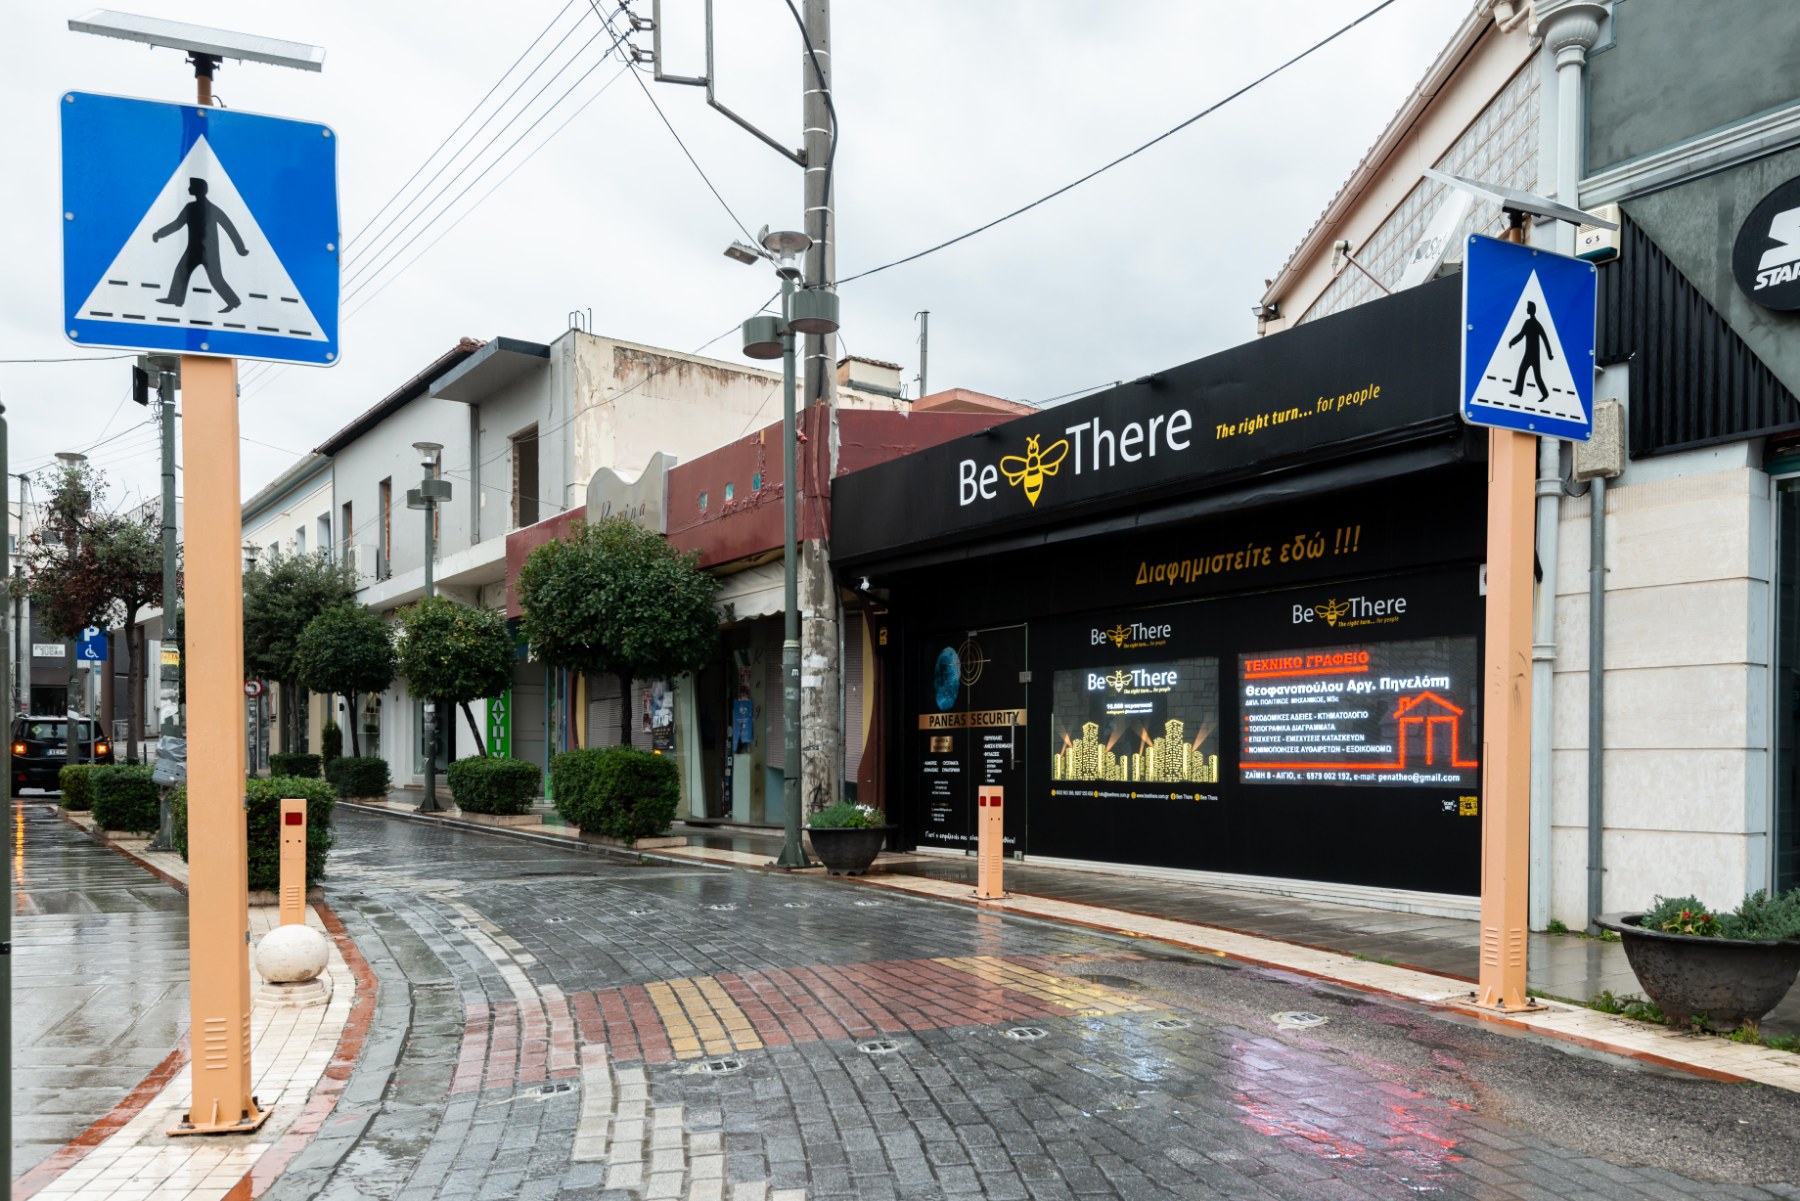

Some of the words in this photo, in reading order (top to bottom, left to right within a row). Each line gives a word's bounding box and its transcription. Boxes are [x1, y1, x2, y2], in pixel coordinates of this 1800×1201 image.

[1216, 422, 1236, 440] The
[1238, 414, 1270, 437] right
[1272, 408, 1314, 426] turn...
[1316, 396, 1334, 414] for
[1336, 384, 1382, 413] people
[959, 458, 999, 507] Be
[1066, 409, 1193, 475] There
[1135, 540, 1272, 586] Διαφημιστείτε
[1279, 530, 1326, 563] εδώ
[1292, 604, 1314, 624] Be
[1348, 595, 1406, 618] There
[1091, 628, 1106, 646] Be
[1130, 622, 1172, 641] There
[1245, 656, 1302, 672] ΤΕΧΝΙΚΟ
[1306, 651, 1369, 667] ΓΡΑΦΕΙΟ
[1088, 674, 1106, 691] Be
[1130, 669, 1177, 687] There
[1246, 678, 1343, 697] Θεοφανοπούλου
[1346, 676, 1376, 694] Αργ.
[1380, 674, 1450, 690] Πηνελόπη
[929, 714, 966, 728] PANEAS
[970, 711, 1020, 726] SECURITY
[1249, 713, 1290, 722] ΟΙΚΟΔΟΜΙΚΕΣ
[1317, 711, 1369, 720] ΚΤΗΜΑΤΟΛΟΓΙΟ
[1291, 723, 1336, 732] ΔΙΑΓΡΑΜΜΑΤΑ
[1378, 773, 1460, 783] penatheo@gmail.com
